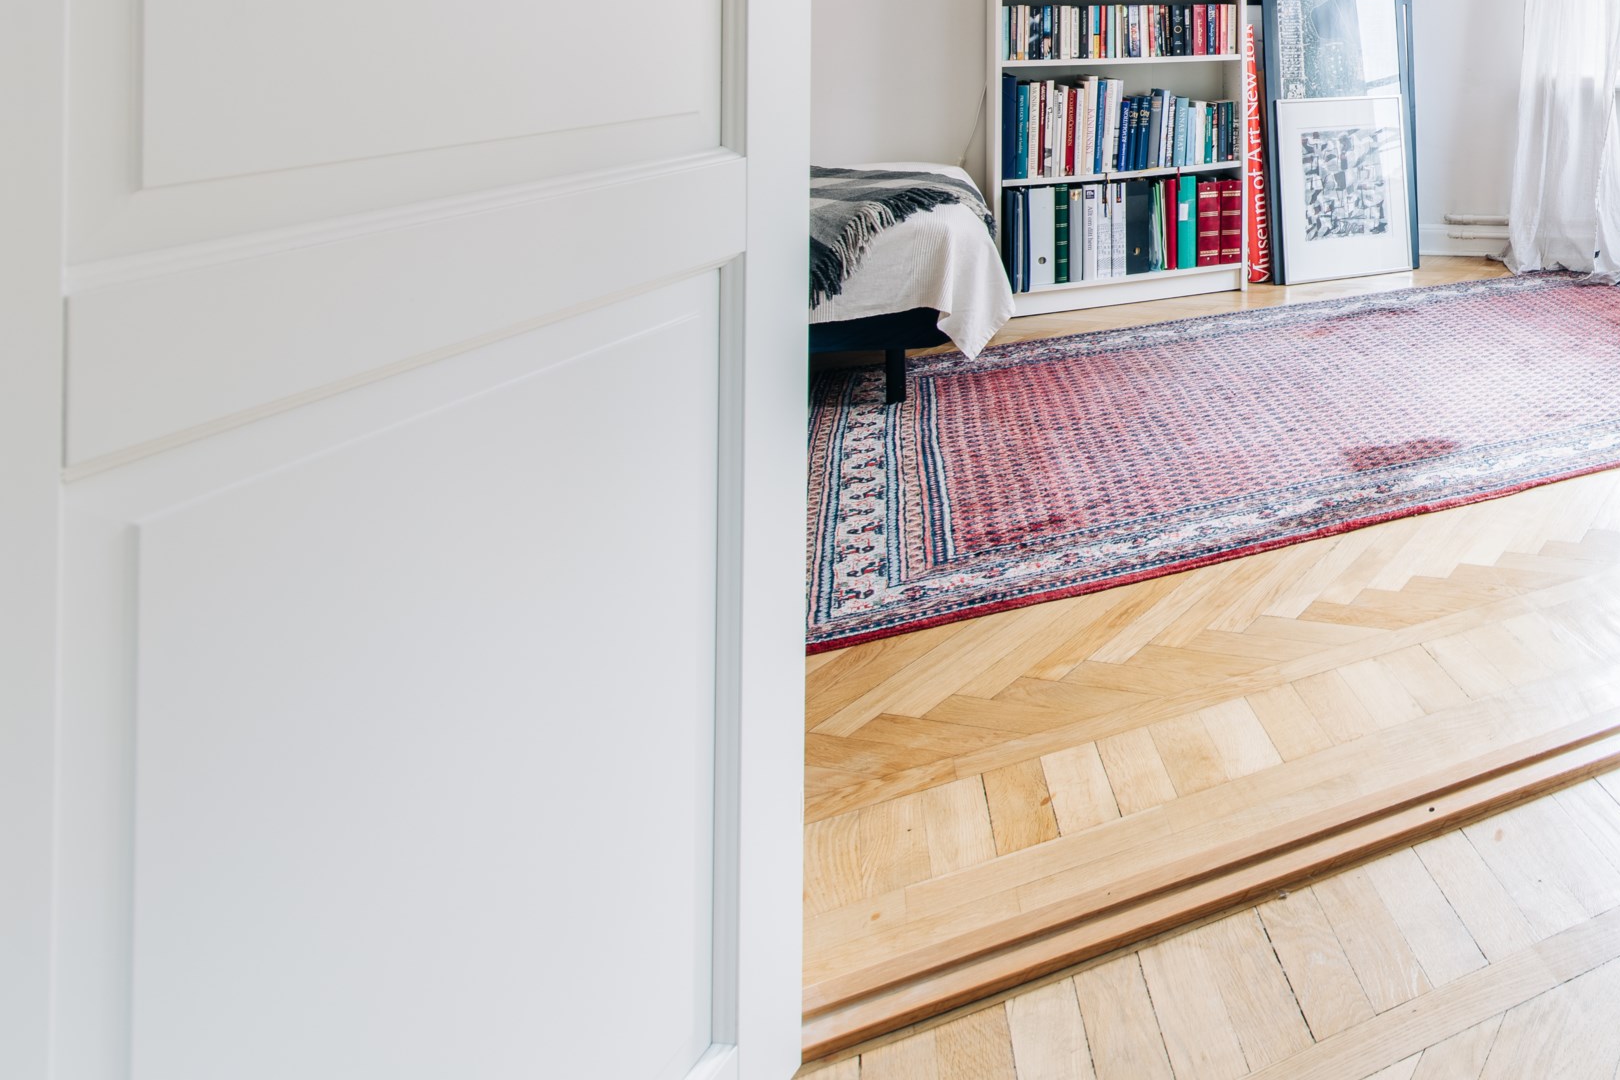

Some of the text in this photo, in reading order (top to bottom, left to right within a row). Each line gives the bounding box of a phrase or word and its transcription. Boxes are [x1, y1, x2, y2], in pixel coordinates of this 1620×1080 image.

[1247, 73, 1259, 120] New
[1129, 111, 1139, 119] City
[1140, 110, 1150, 118] City
[1086, 108, 1095, 155] KANDINSKY
[1177, 134, 1185, 152] MAT
[1247, 126, 1262, 162] Art
[1247, 168, 1263, 185] of
[1088, 217, 1092, 225] om
[1250, 187, 1271, 281] Museum
